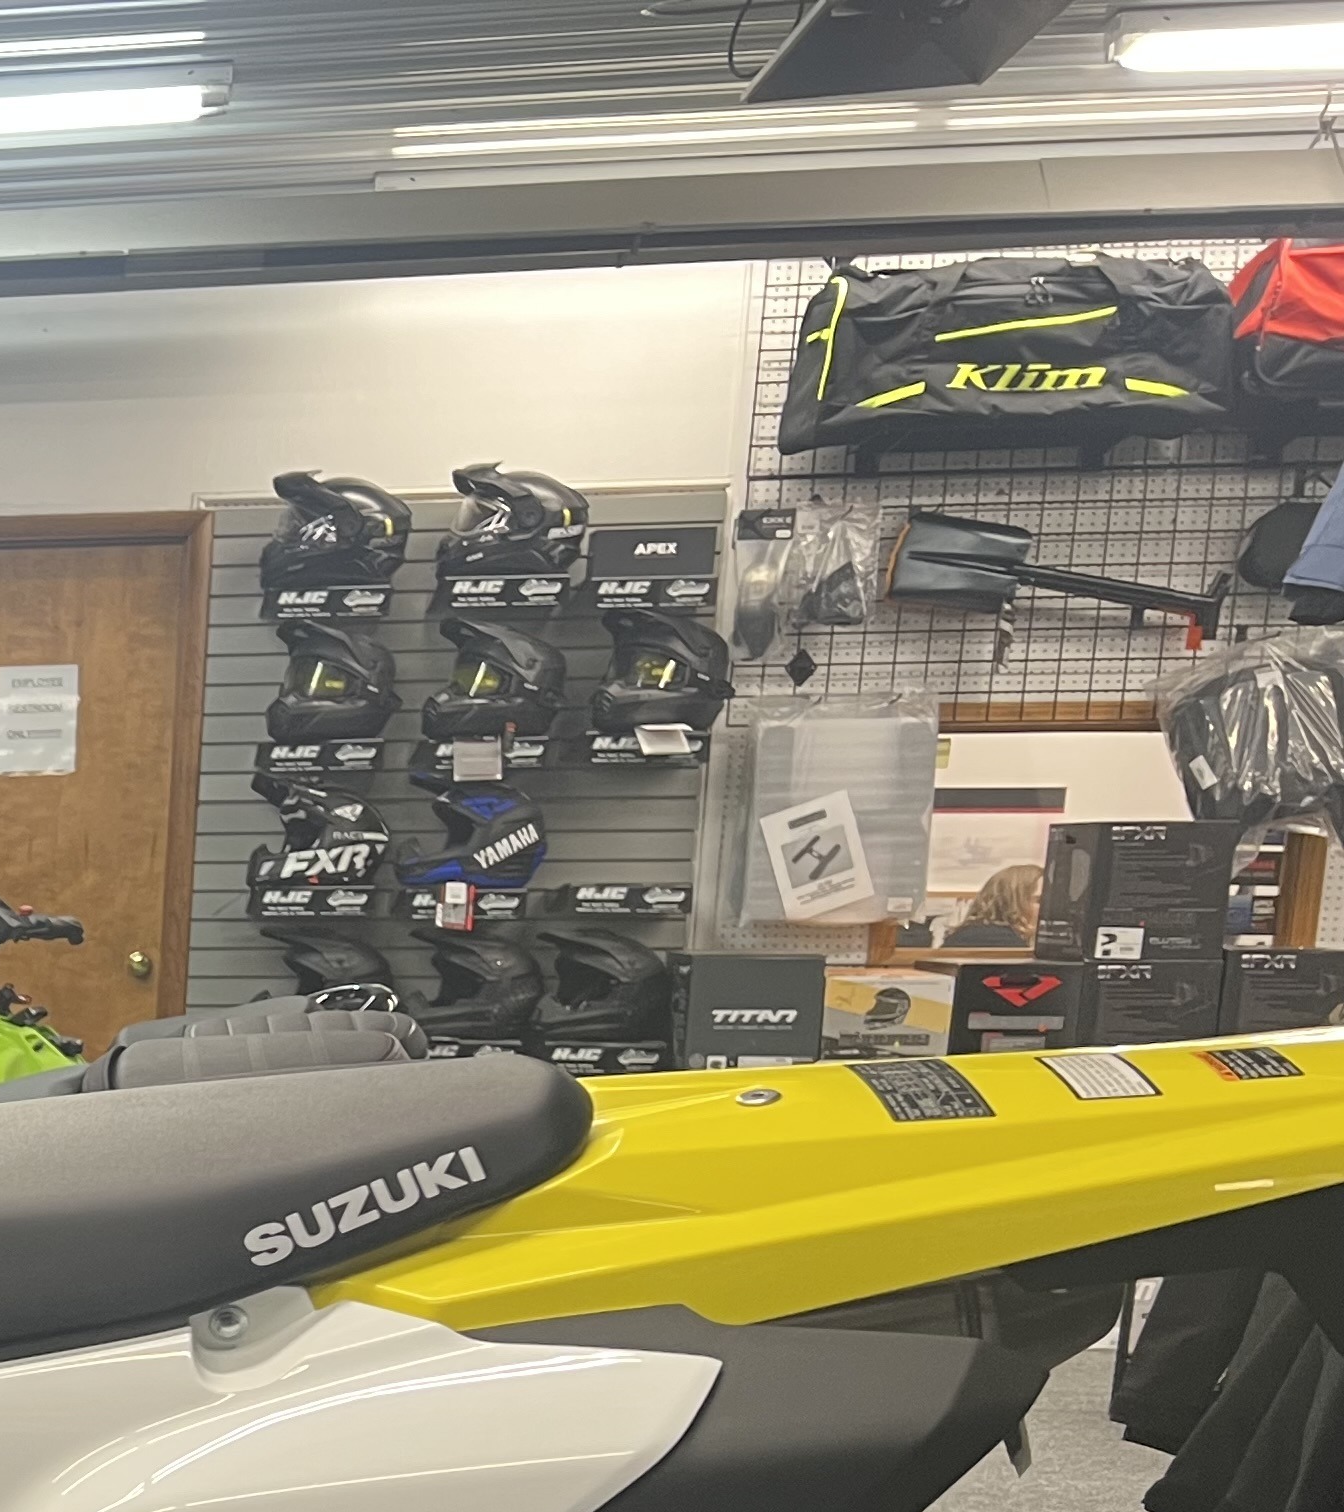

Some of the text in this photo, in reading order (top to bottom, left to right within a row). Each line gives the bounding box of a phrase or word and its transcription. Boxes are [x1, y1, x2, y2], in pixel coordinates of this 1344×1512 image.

[946, 363, 1107, 391] Klim
[280, 844, 370, 879] FXR
[473, 823, 540, 869] YAMAHA
[711, 1009, 798, 1024] TITAN
[243, 1145, 487, 1267] SUZUKI
